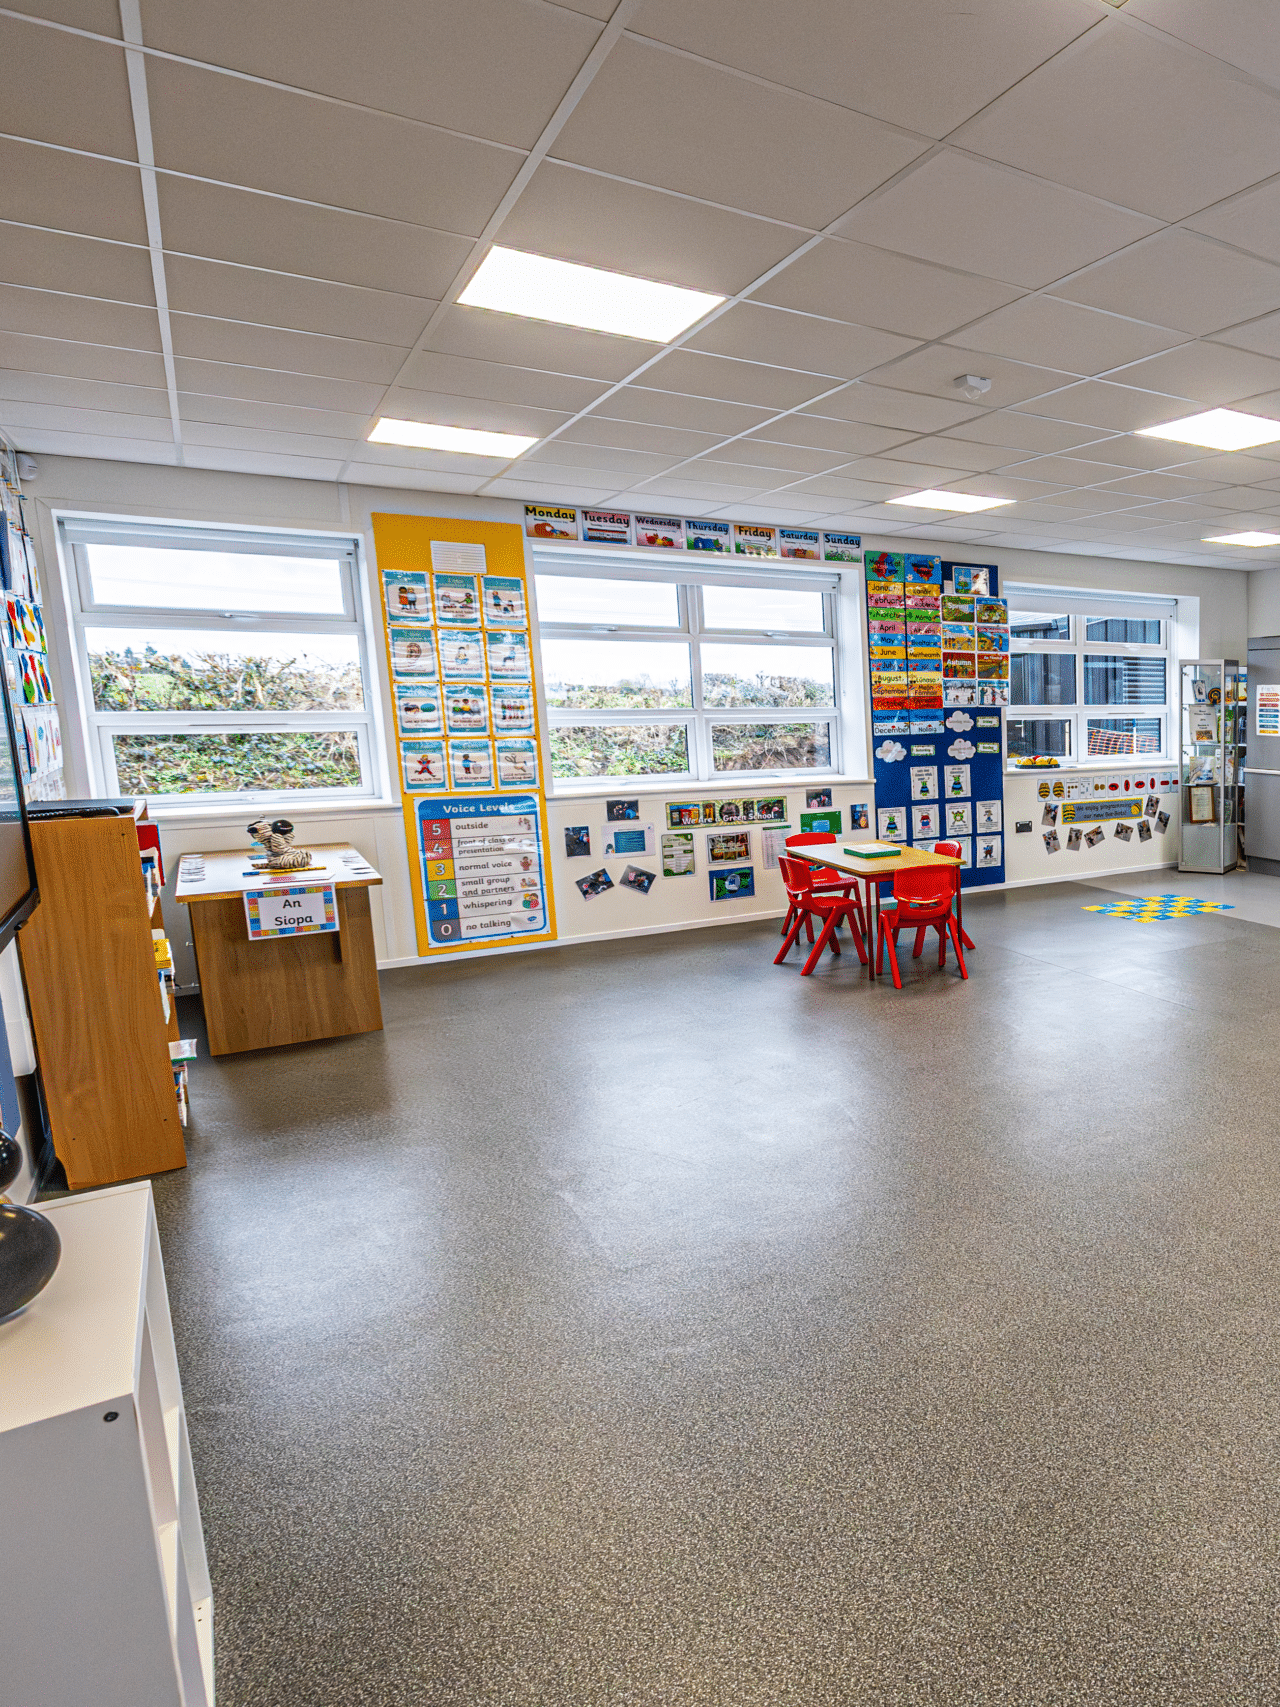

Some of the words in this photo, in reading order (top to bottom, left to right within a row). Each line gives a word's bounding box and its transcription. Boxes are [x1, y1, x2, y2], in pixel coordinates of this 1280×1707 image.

[525, 506, 576, 523] Monday
[583, 511, 630, 528] Tuesday
[636, 517, 681, 529] Wednesday
[686, 521, 729, 535] Thursday
[739, 526, 772, 541] Friday
[780, 530, 819, 543] Saturday
[824, 534, 861, 548] Sunday
[879, 624, 896, 633] April
[443, 805, 476, 814] Voice
[479, 802, 515, 812] Levels
[699, 816, 713, 824] Are
[723, 814, 747, 822] Green
[748, 811, 775, 820] School
[431, 823, 442, 835] 5
[455, 822, 489, 830] outside
[432, 843, 444, 854] 4
[458, 846, 504, 855] presentation
[457, 839, 476, 848] front
[435, 863, 445, 875] 3
[459, 862, 490, 871] normal
[492, 860, 513, 868] voice
[437, 885, 447, 896] 2
[461, 879, 485, 887] small
[487, 877, 511, 886] group
[481, 885, 515, 895] partners
[282, 899, 302, 909] An
[440, 903, 447, 915] 1
[463, 898, 513, 910] whispering
[274, 915, 314, 926] Siopa
[440, 924, 452, 936] 0
[466, 923, 477, 931] no
[480, 919, 512, 929] talking
